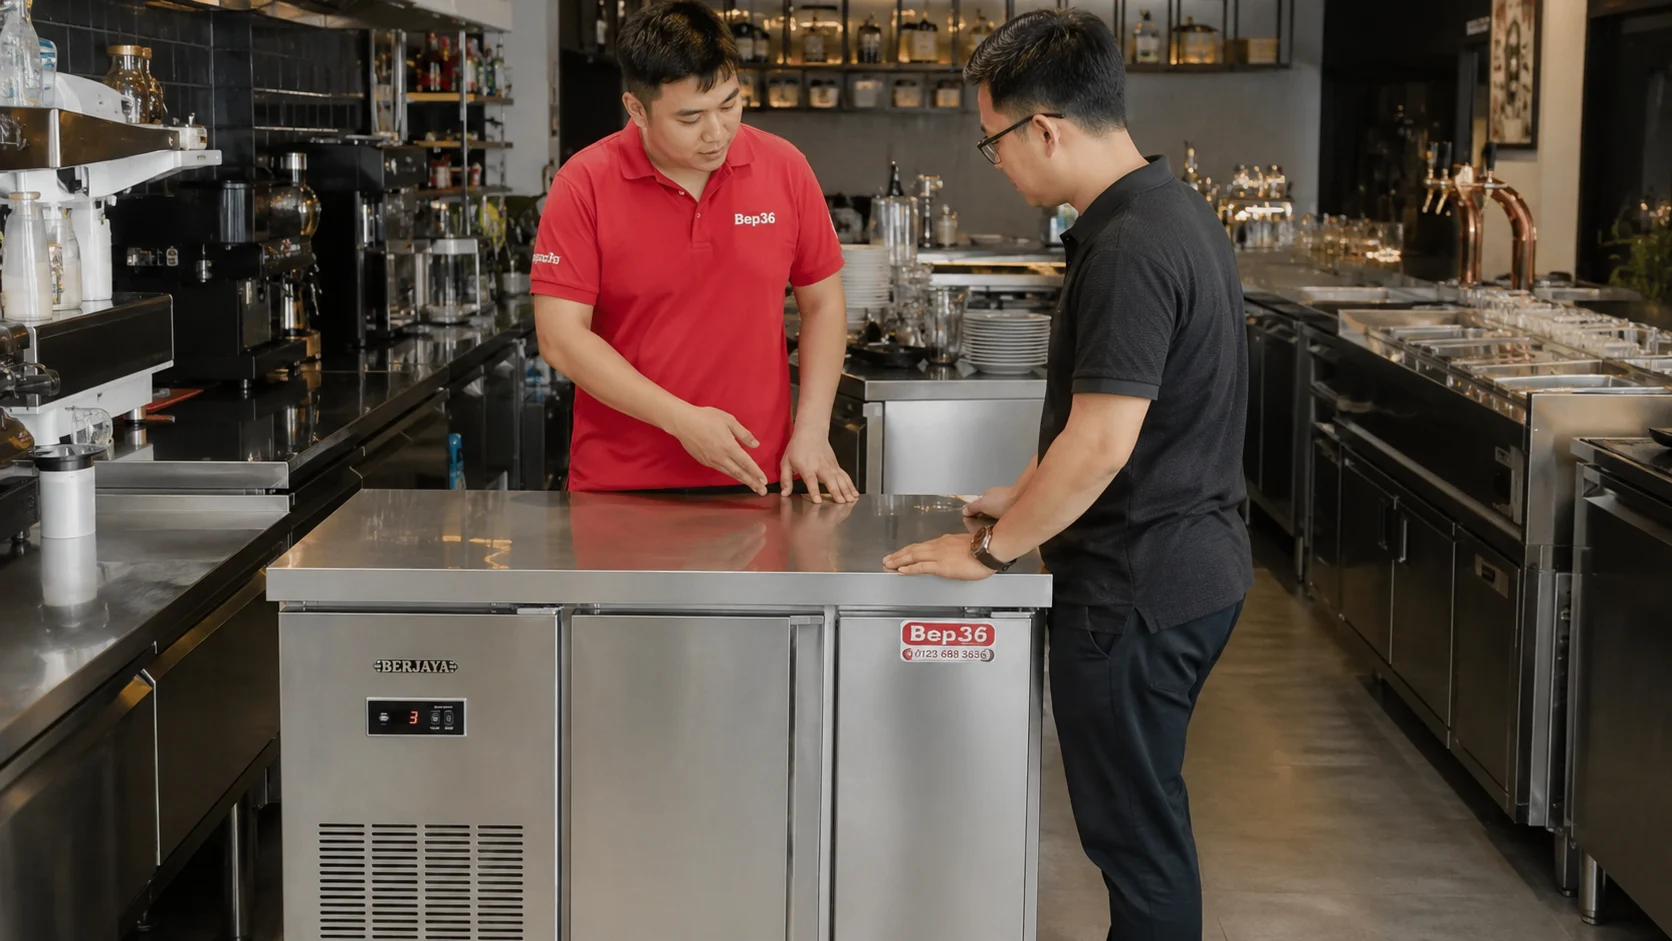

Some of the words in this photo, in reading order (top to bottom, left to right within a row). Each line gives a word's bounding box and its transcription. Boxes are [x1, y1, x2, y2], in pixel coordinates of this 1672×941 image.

[735, 212, 776, 227] Bep36
[910, 625, 987, 645] Bep36
[382, 660, 449, 673] BERJAYA
[409, 711, 418, 724] 3
